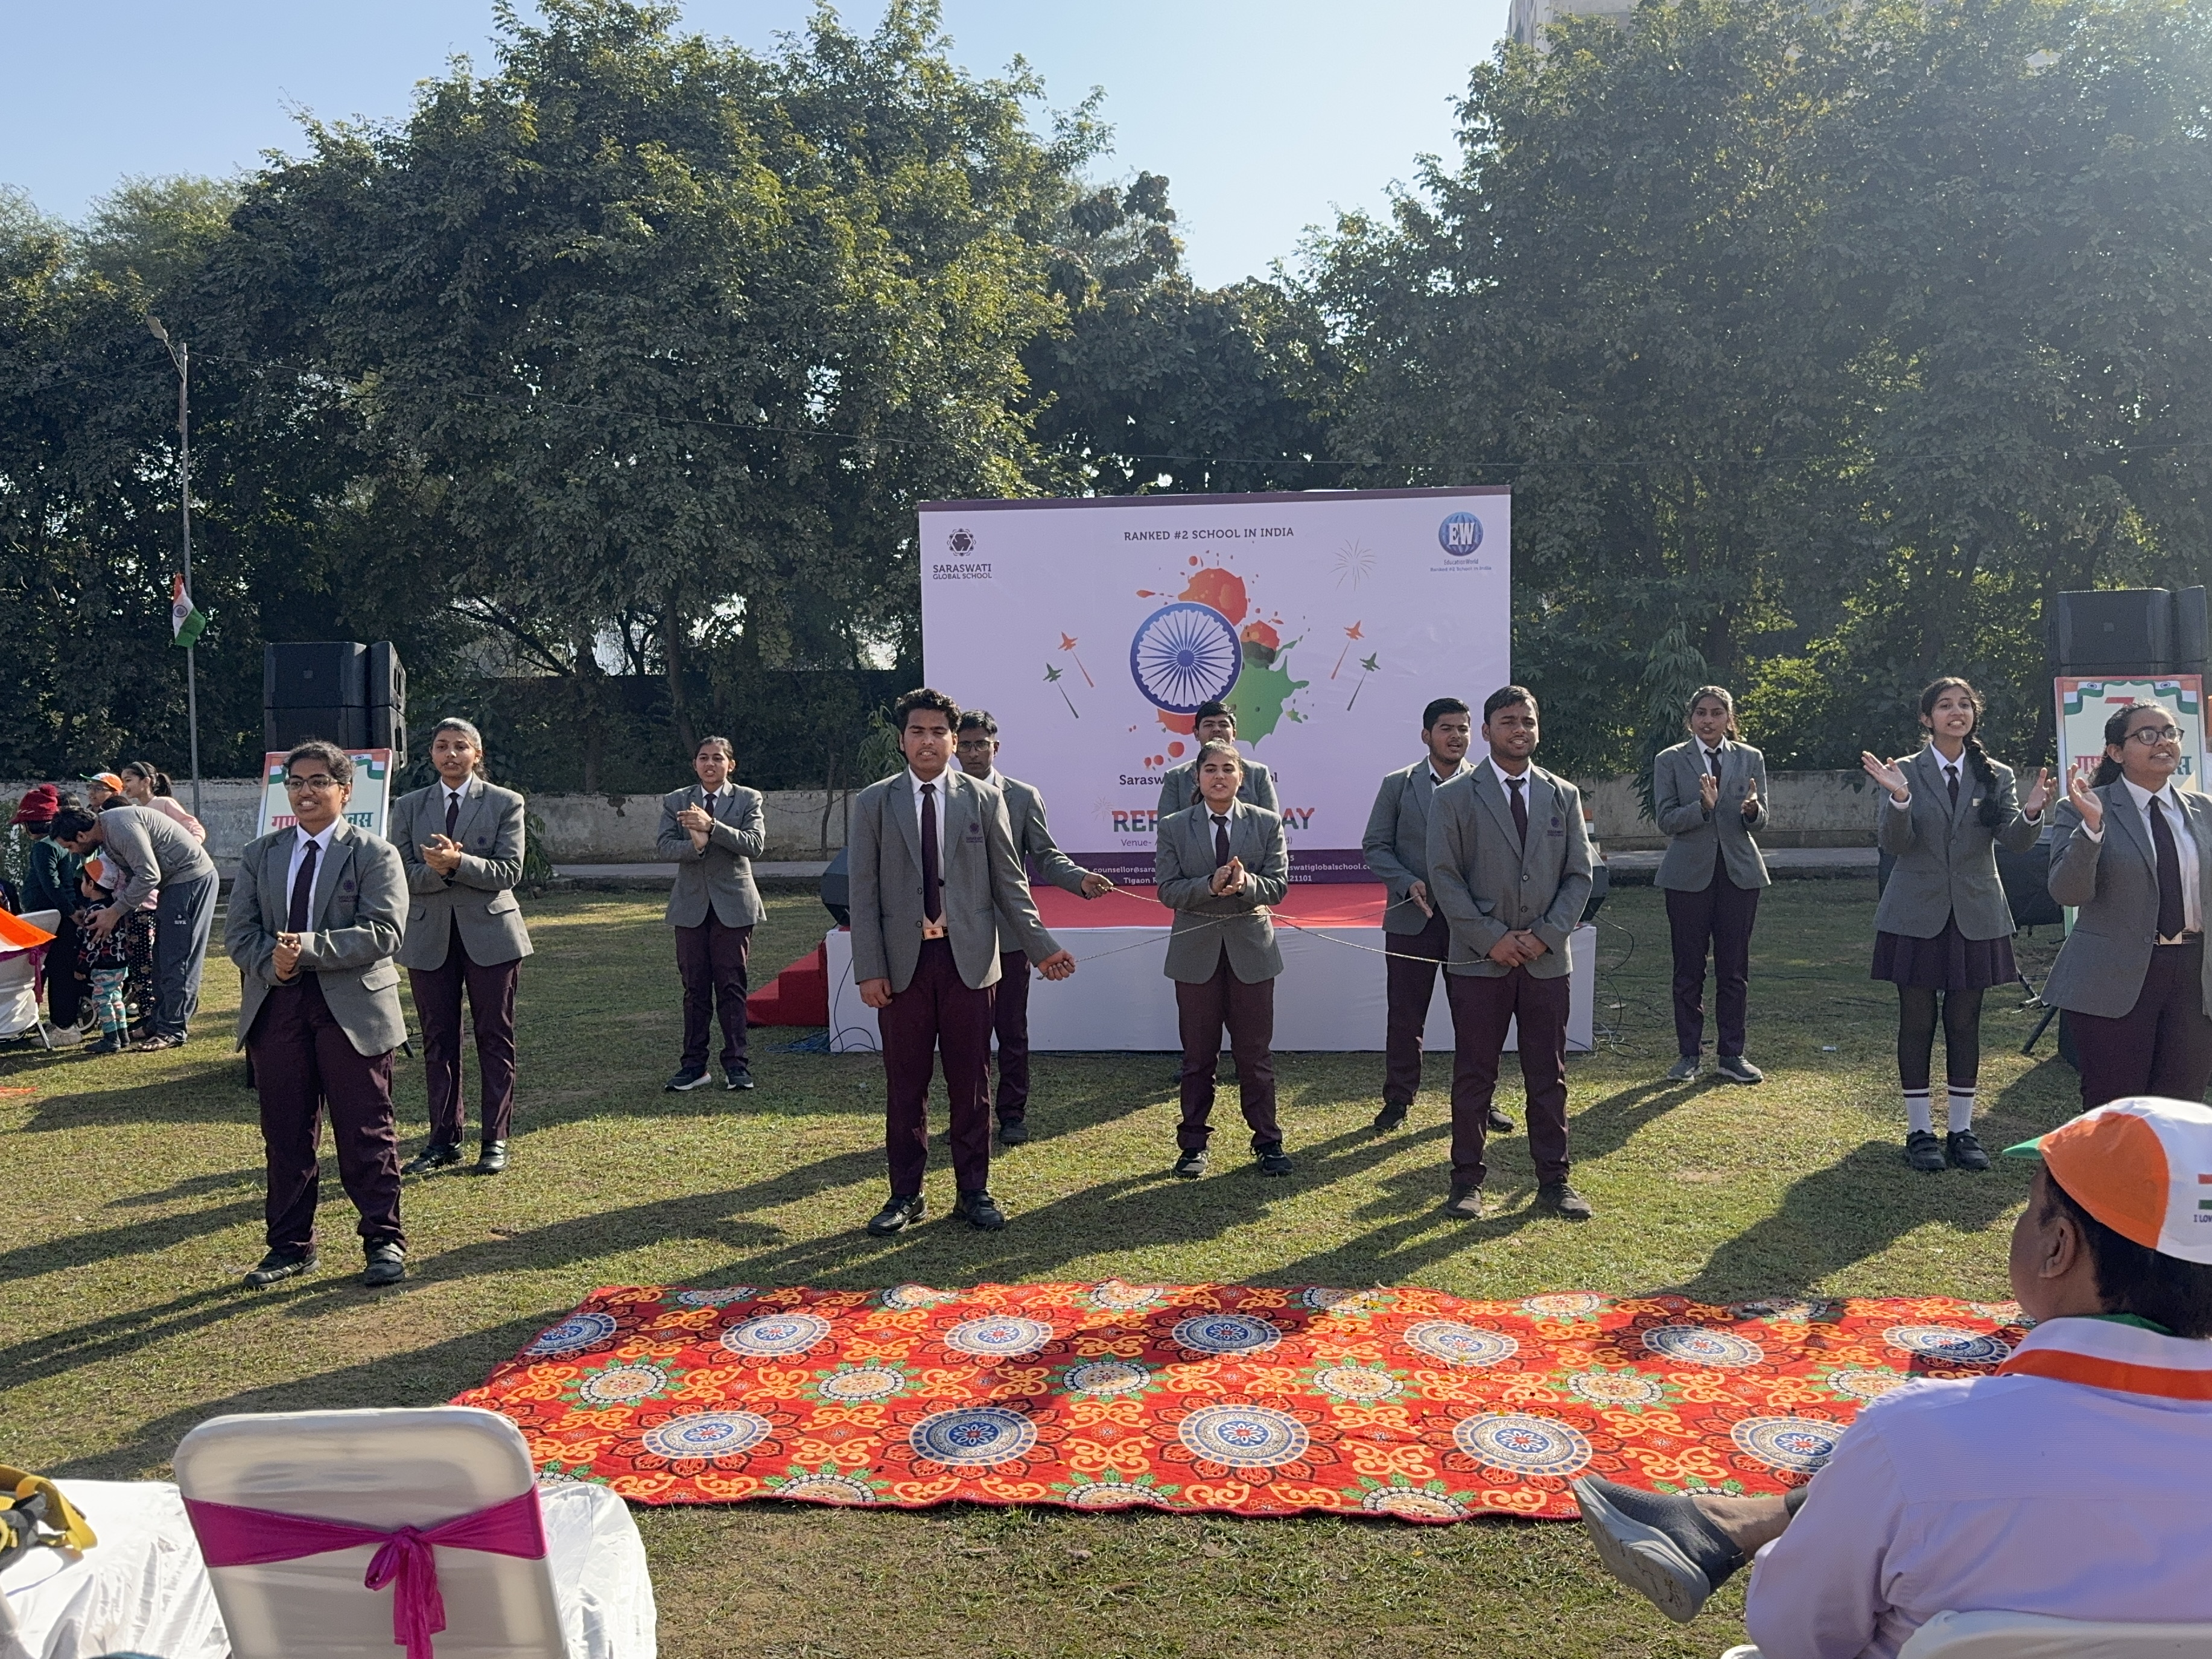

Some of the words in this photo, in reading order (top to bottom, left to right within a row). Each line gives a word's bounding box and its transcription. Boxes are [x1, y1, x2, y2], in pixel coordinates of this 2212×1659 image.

[1124, 531, 1170, 541] RANKED
[1174, 530, 1189, 540] #2
[1192, 529, 1241, 539] SCHOOL
[1244, 528, 1257, 538] IN
[1260, 527, 1294, 538] INDIA
[1449, 522, 1475, 545] EW
[933, 563, 991, 573] SARASWATI
[1119, 775, 1165, 785] Sarasw
[1282, 807, 1315, 830] AY
[1123, 877, 1151, 885] Tigaon
